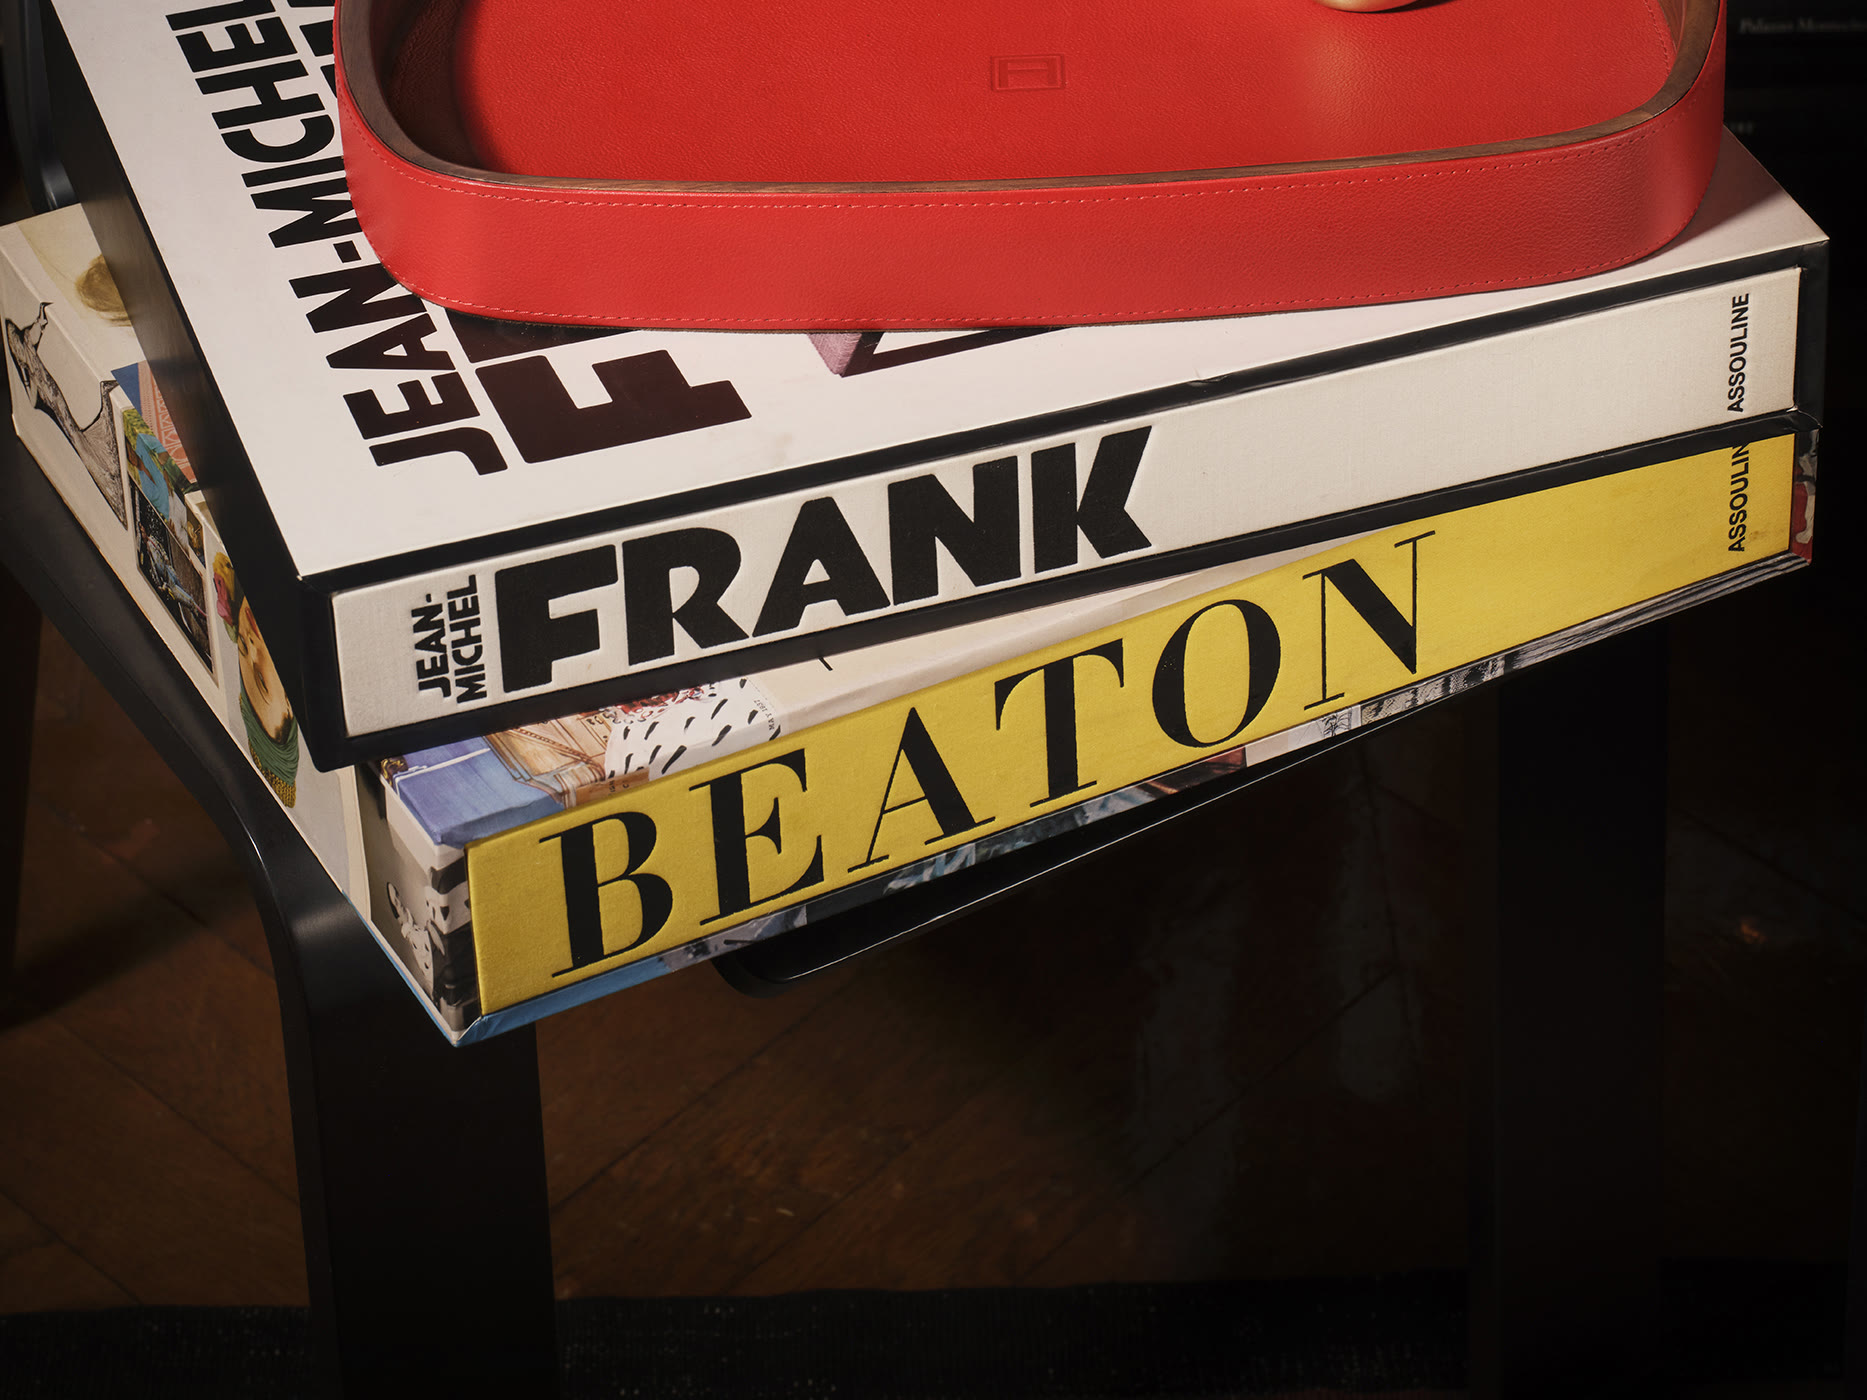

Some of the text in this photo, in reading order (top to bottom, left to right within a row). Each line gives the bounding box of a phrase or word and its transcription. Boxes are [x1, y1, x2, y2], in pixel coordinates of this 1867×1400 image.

[1727, 292, 1750, 413] ASSOULINE
[1727, 440, 1750, 552] ASSOULIN
[494, 426, 1153, 693] FRANK
[411, 593, 452, 698] JEAN-
[446, 574, 488, 704] MICHEL
[539, 530, 1436, 980] BEATON
[766, 711, 776, 731] MAY
